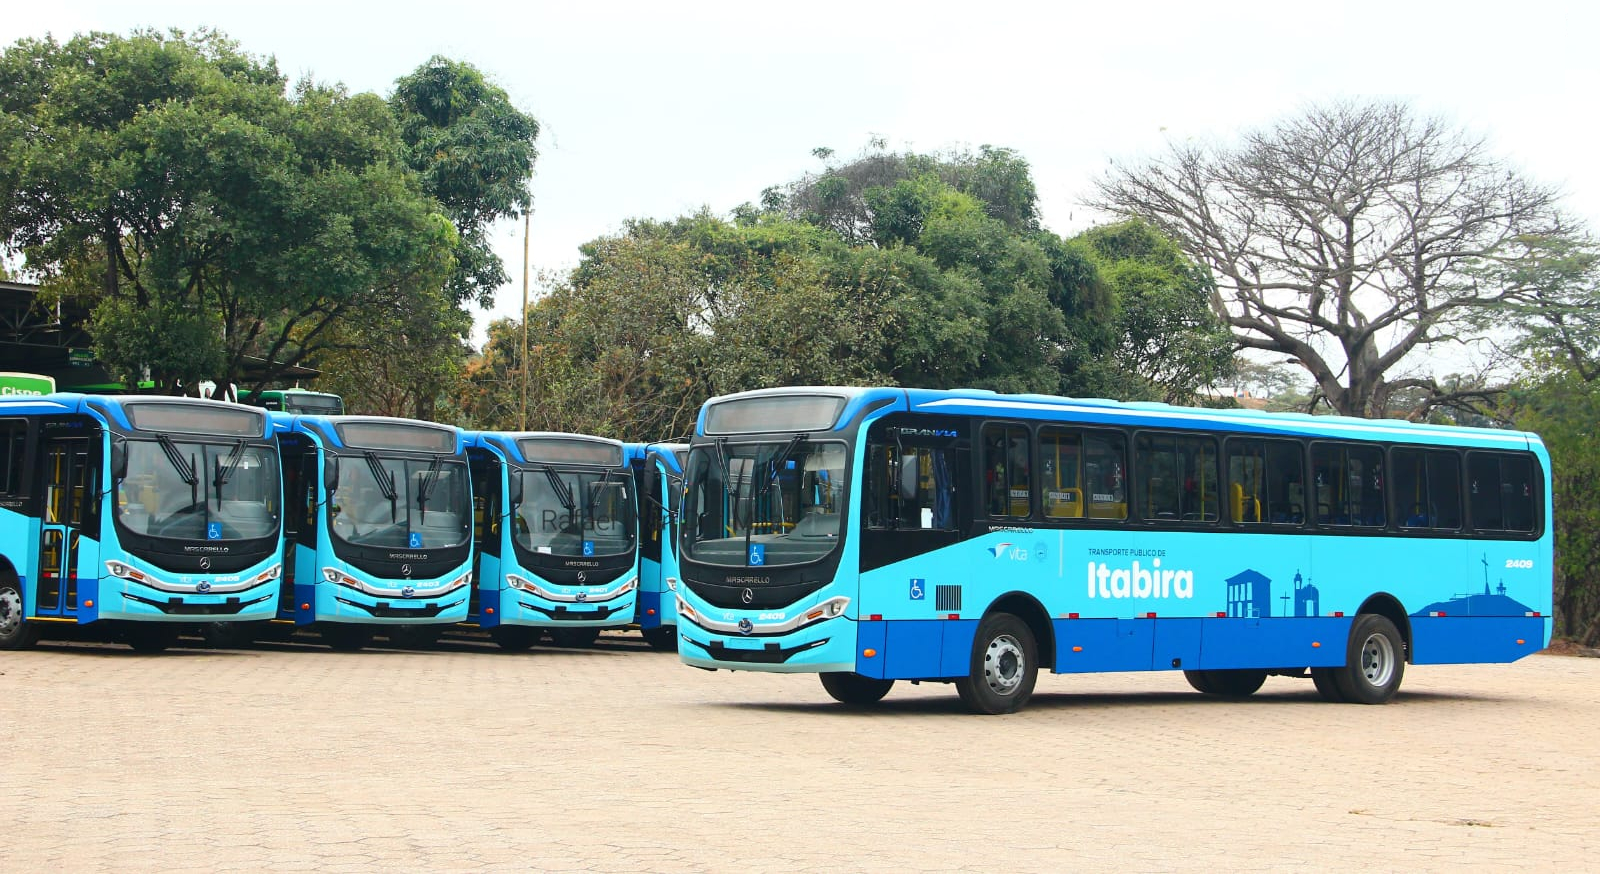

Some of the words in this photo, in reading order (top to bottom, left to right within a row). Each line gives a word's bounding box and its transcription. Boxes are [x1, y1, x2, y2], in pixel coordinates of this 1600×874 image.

[1088, 548, 1129, 556] TRANSPORTE
[1157, 549, 1166, 557] DE
[1505, 559, 1533, 569] 2409
[726, 576, 770, 584] MASCARELLO
[1088, 558, 1193, 599] Itabira
[758, 612, 786, 621] 2409
